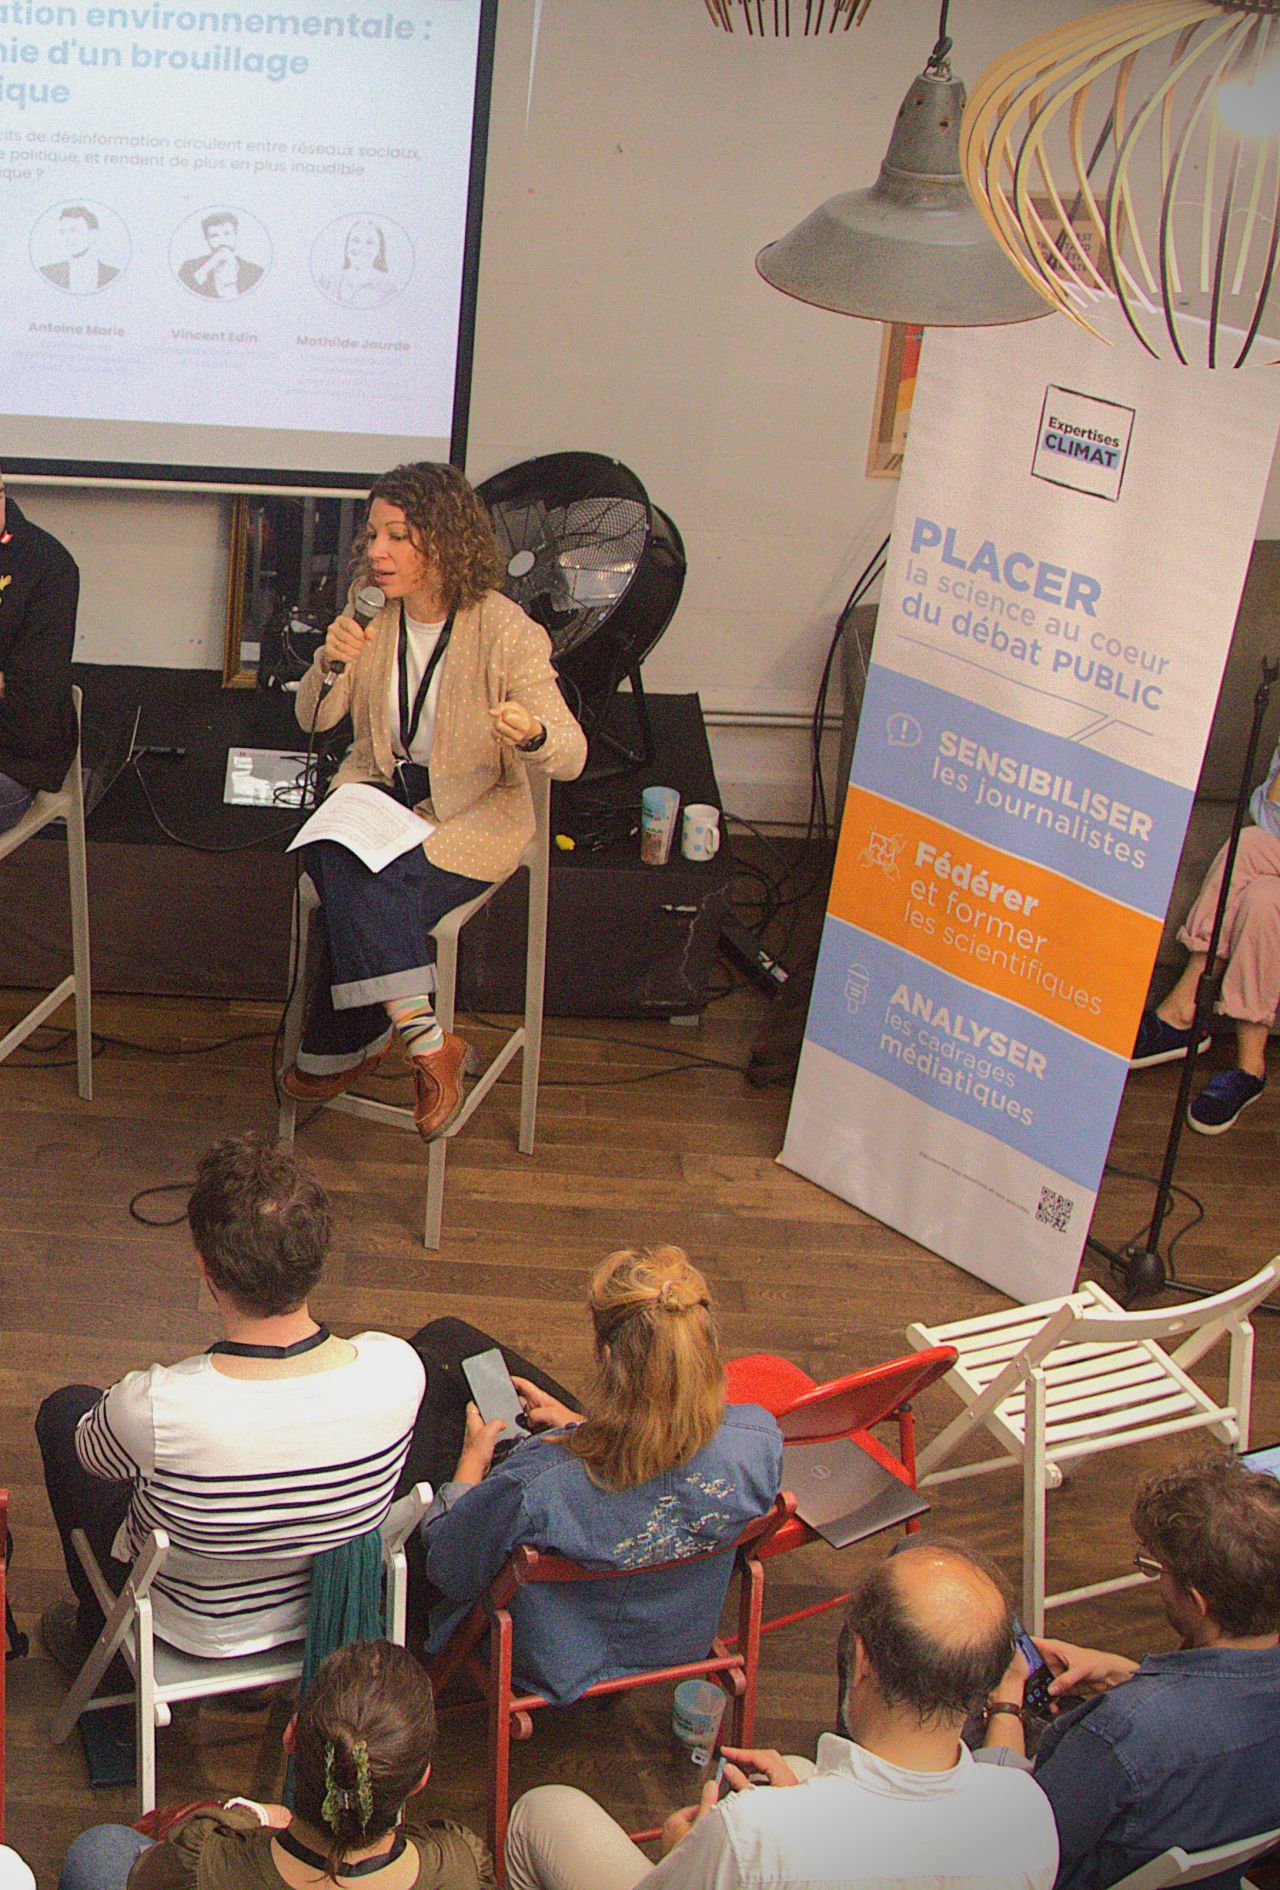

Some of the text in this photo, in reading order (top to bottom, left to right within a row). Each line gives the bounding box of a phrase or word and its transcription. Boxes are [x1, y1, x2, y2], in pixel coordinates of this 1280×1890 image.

[86, 0, 415, 41] environnementale
[424, 17, 433, 40] :
[48, 38, 121, 68] d'un
[131, 41, 310, 82] brouillage
[26, 129, 48, 143] de
[51, 130, 169, 148] désinformation
[174, 136, 242, 151] circulent
[246, 141, 288, 153] entre
[291, 142, 354, 156] réseaux
[84, 151, 99, 165] et
[104, 152, 165, 167] rendent
[170, 154, 189, 168] de
[193, 155, 225, 172] plus
[230, 159, 250, 171] en
[254, 159, 287, 174] plus
[291, 159, 366, 176] inaudible
[28, 322, 125, 337] Antoine Marie
[171, 328, 258, 344] Vincent Edin
[296, 335, 359, 349] Mathilde
[1045, 434, 1117, 467] CLIMAT
[1048, 416, 1120, 448] Expertises
[910, 516, 1102, 618] PLACER
[902, 592, 1163, 710] du débat PUBLIC
[906, 559, 1170, 675] la science au coeur
[932, 756, 1147, 870] les journalistes
[939, 730, 1153, 842] SENSIBILISER
[911, 879, 1048, 954] et former
[914, 840, 1040, 917] Fédérer
[904, 900, 1103, 1015] les scientifiques
[884, 1005, 1016, 1088] les cadrages
[888, 983, 1048, 1080] ANALYSER
[880, 1032, 1033, 1126] médiatiques
